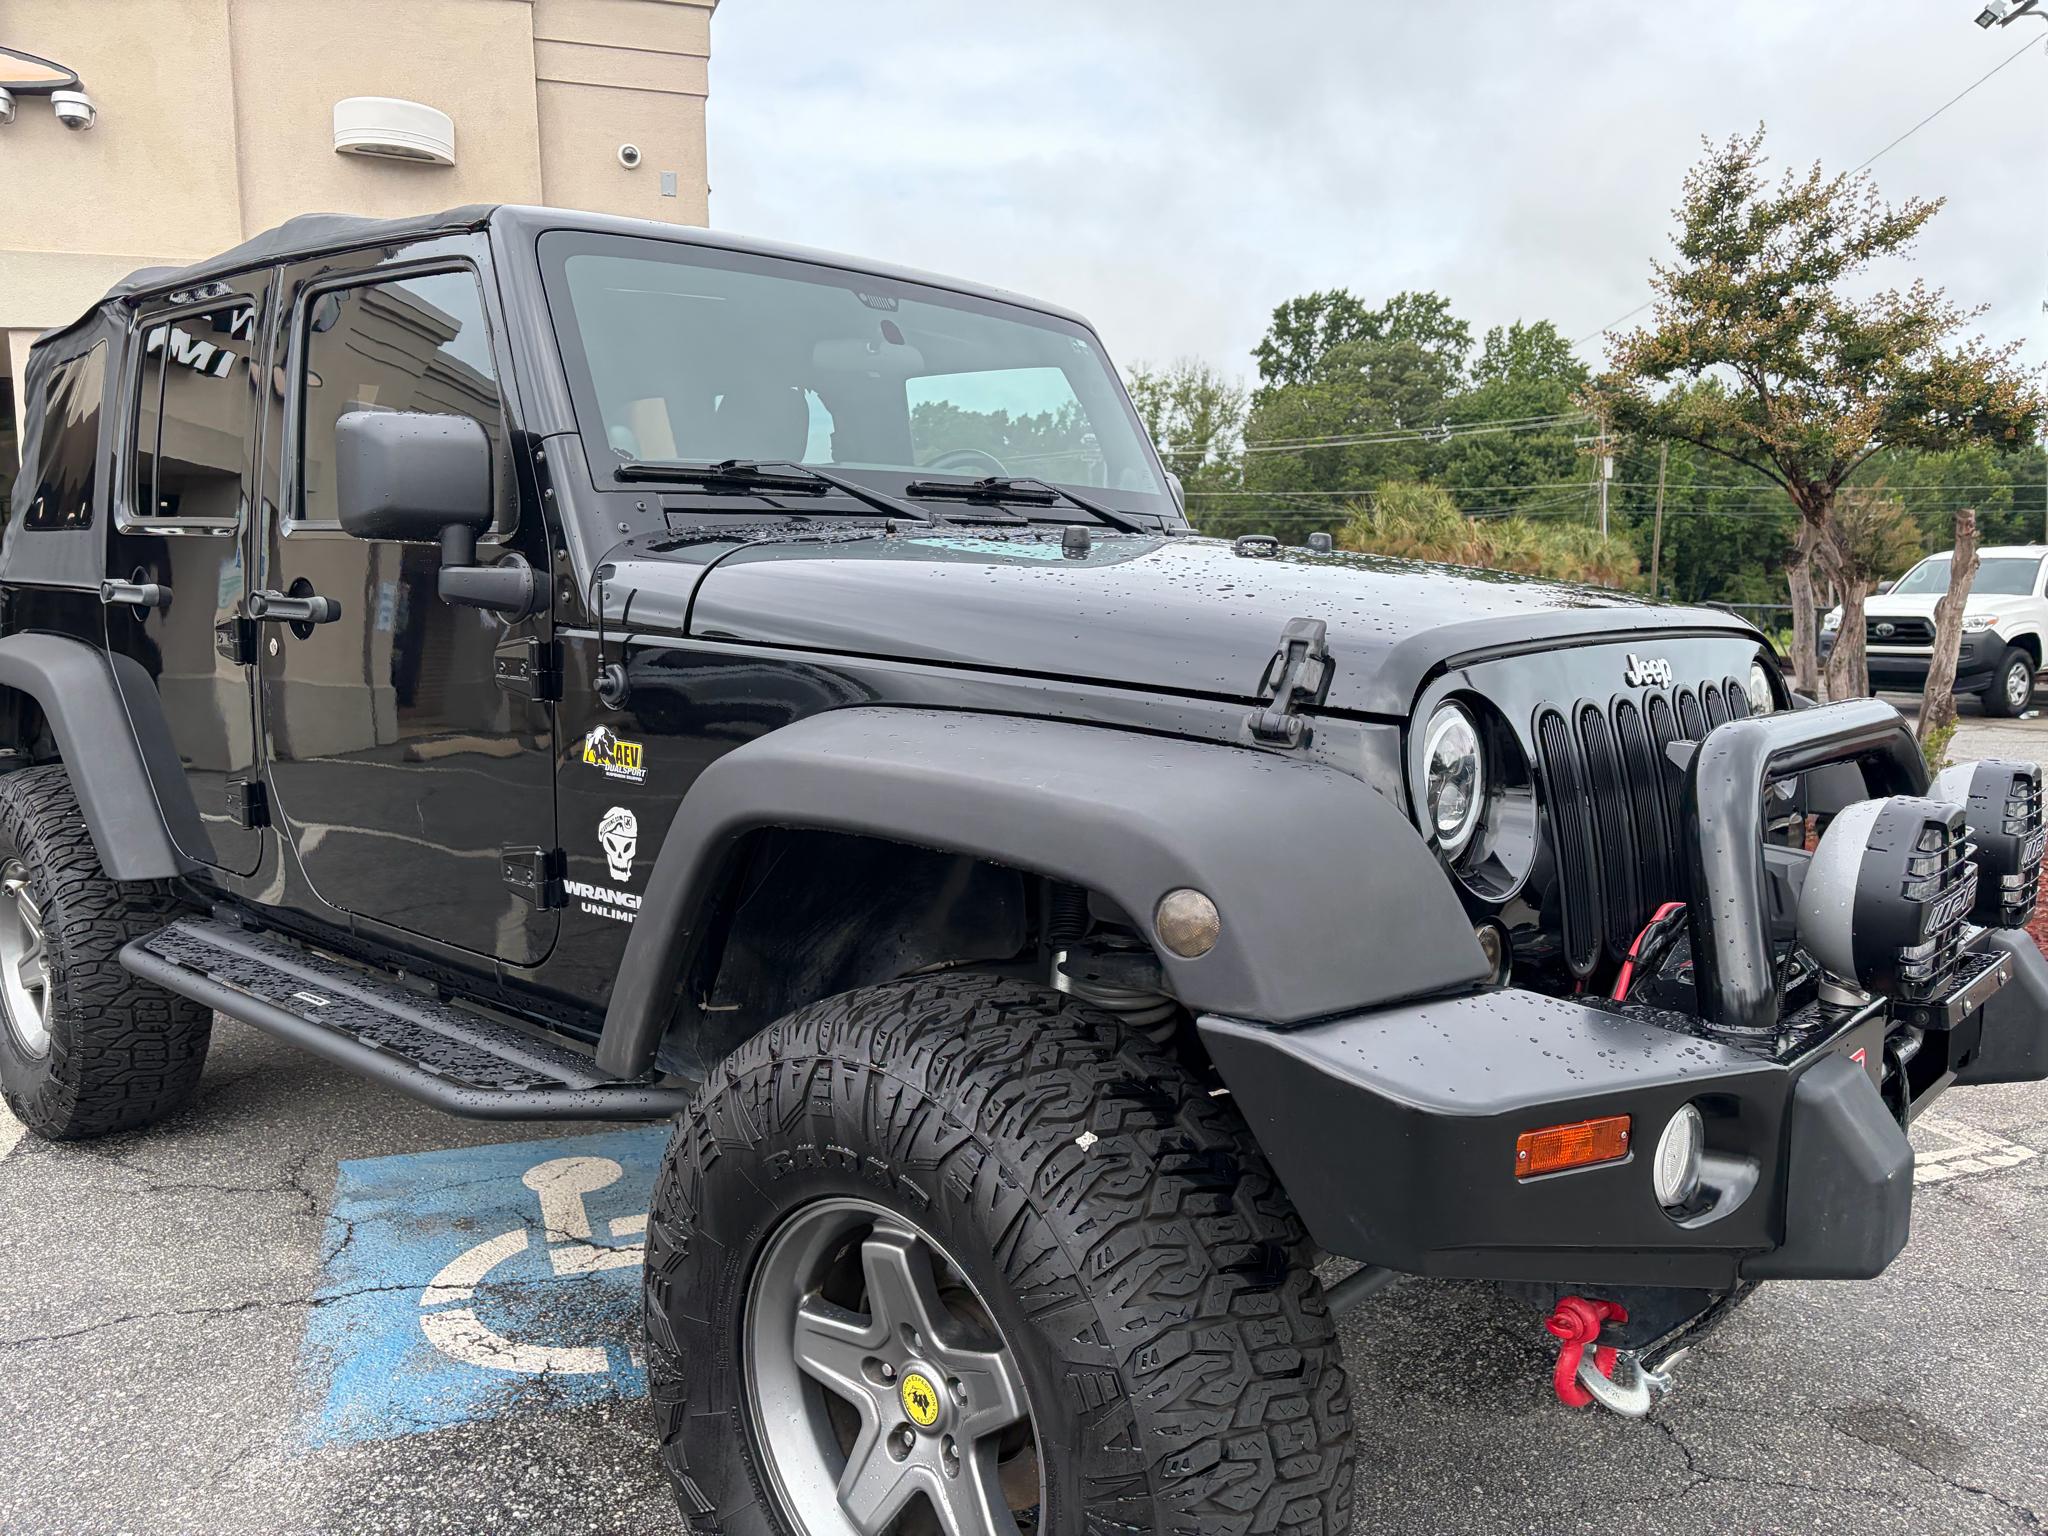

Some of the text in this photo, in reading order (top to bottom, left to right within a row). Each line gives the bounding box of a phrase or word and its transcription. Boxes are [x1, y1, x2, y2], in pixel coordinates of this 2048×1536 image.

[1626, 652, 1673, 689] Jeep
[616, 744, 639, 767] AEV
[604, 764, 647, 778] DUALSPORT
